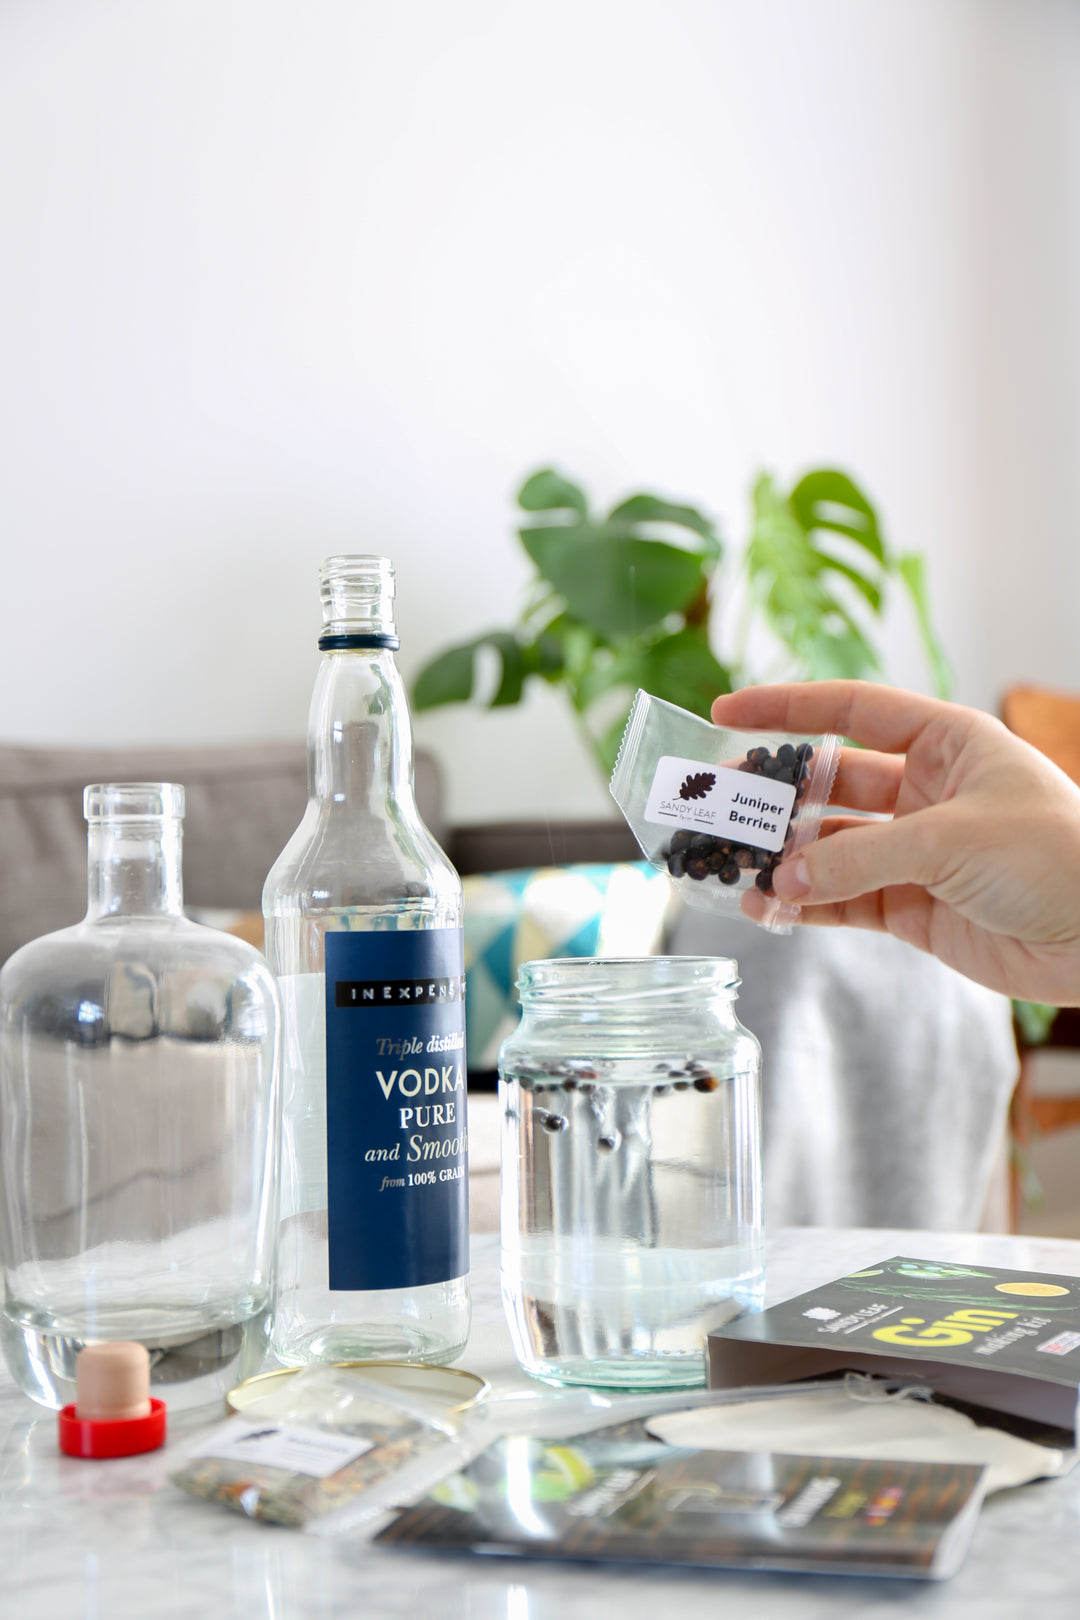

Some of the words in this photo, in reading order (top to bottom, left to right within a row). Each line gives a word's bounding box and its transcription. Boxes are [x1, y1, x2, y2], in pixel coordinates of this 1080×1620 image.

[660, 800, 693, 813] SANDY
[693, 809, 717, 819] LEAF
[731, 792, 785, 815] Juniper
[729, 810, 777, 833] Berries
[376, 1036, 424, 1061] Triple
[375, 1064, 465, 1101] VODKA
[399, 1102, 456, 1129] PURE
[364, 1143, 400, 1162] and
[379, 1176, 405, 1192] from
[407, 1171, 436, 1187] 100%
[872, 1308, 1019, 1347] Gin
